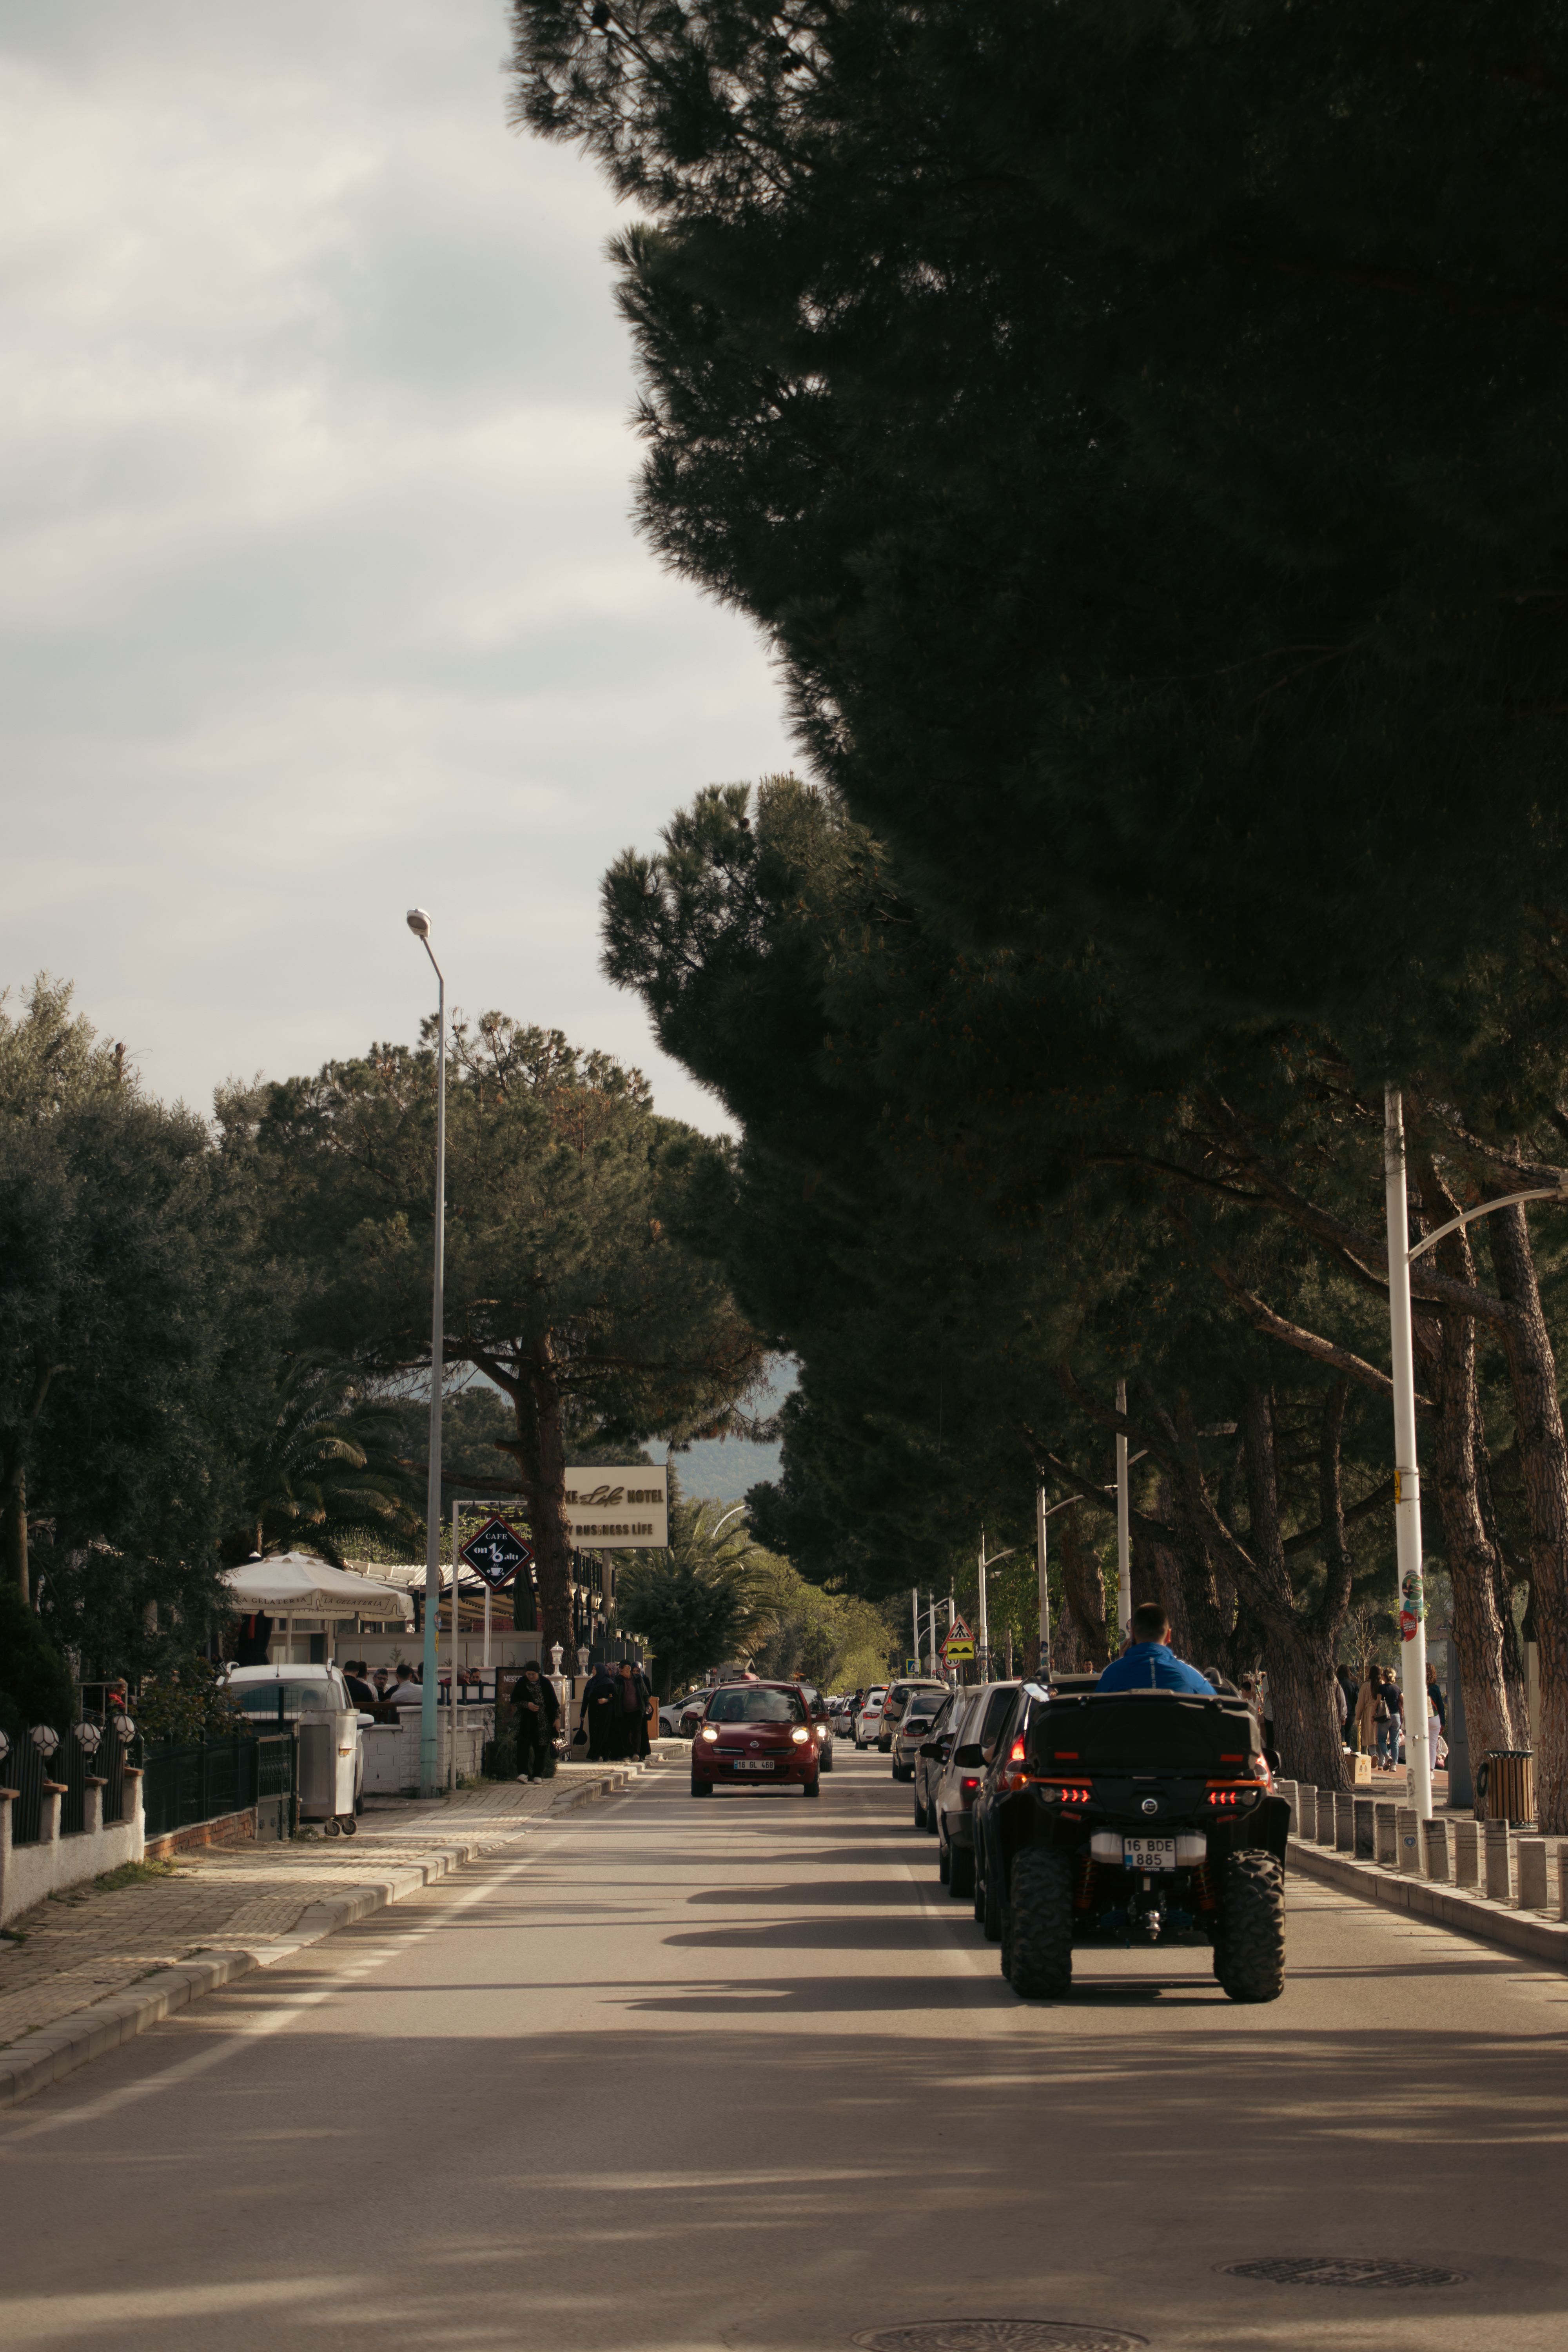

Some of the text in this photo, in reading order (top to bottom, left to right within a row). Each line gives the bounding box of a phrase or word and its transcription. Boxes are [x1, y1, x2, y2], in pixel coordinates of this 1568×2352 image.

[566, 1490, 578, 1504] KE
[579, 1485, 624, 1507] Life
[632, 1522, 653, 1535] LİFE
[1127, 1840, 1173, 1852] 16 BDE
[1137, 1854, 1161, 1865] 885
